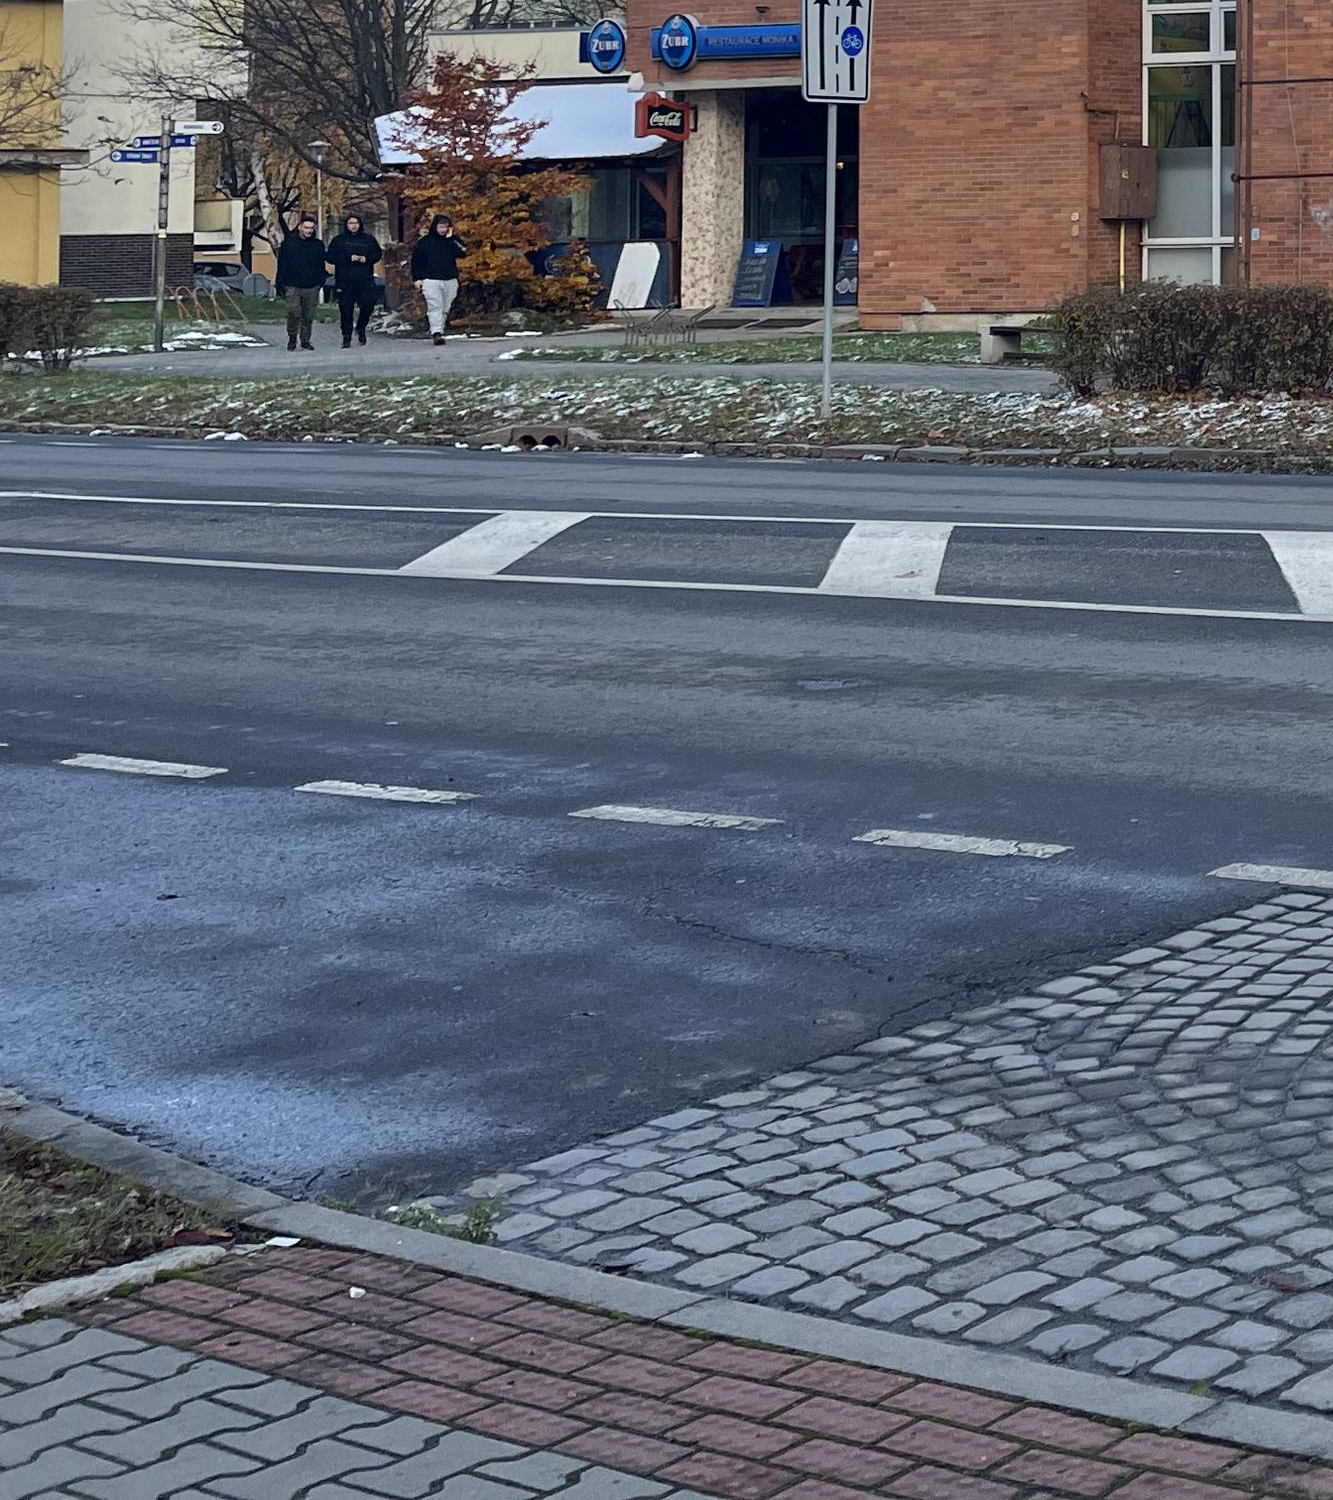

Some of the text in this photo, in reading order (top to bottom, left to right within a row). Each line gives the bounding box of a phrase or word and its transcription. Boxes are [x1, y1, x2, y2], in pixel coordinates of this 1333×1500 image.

[592, 38, 619, 53] ZUBR
[662, 35, 689, 49] ZUBR
[708, 35, 794, 46] RESTAURACE MONIKA
[649, 112, 682, 127] Coca-Cola
